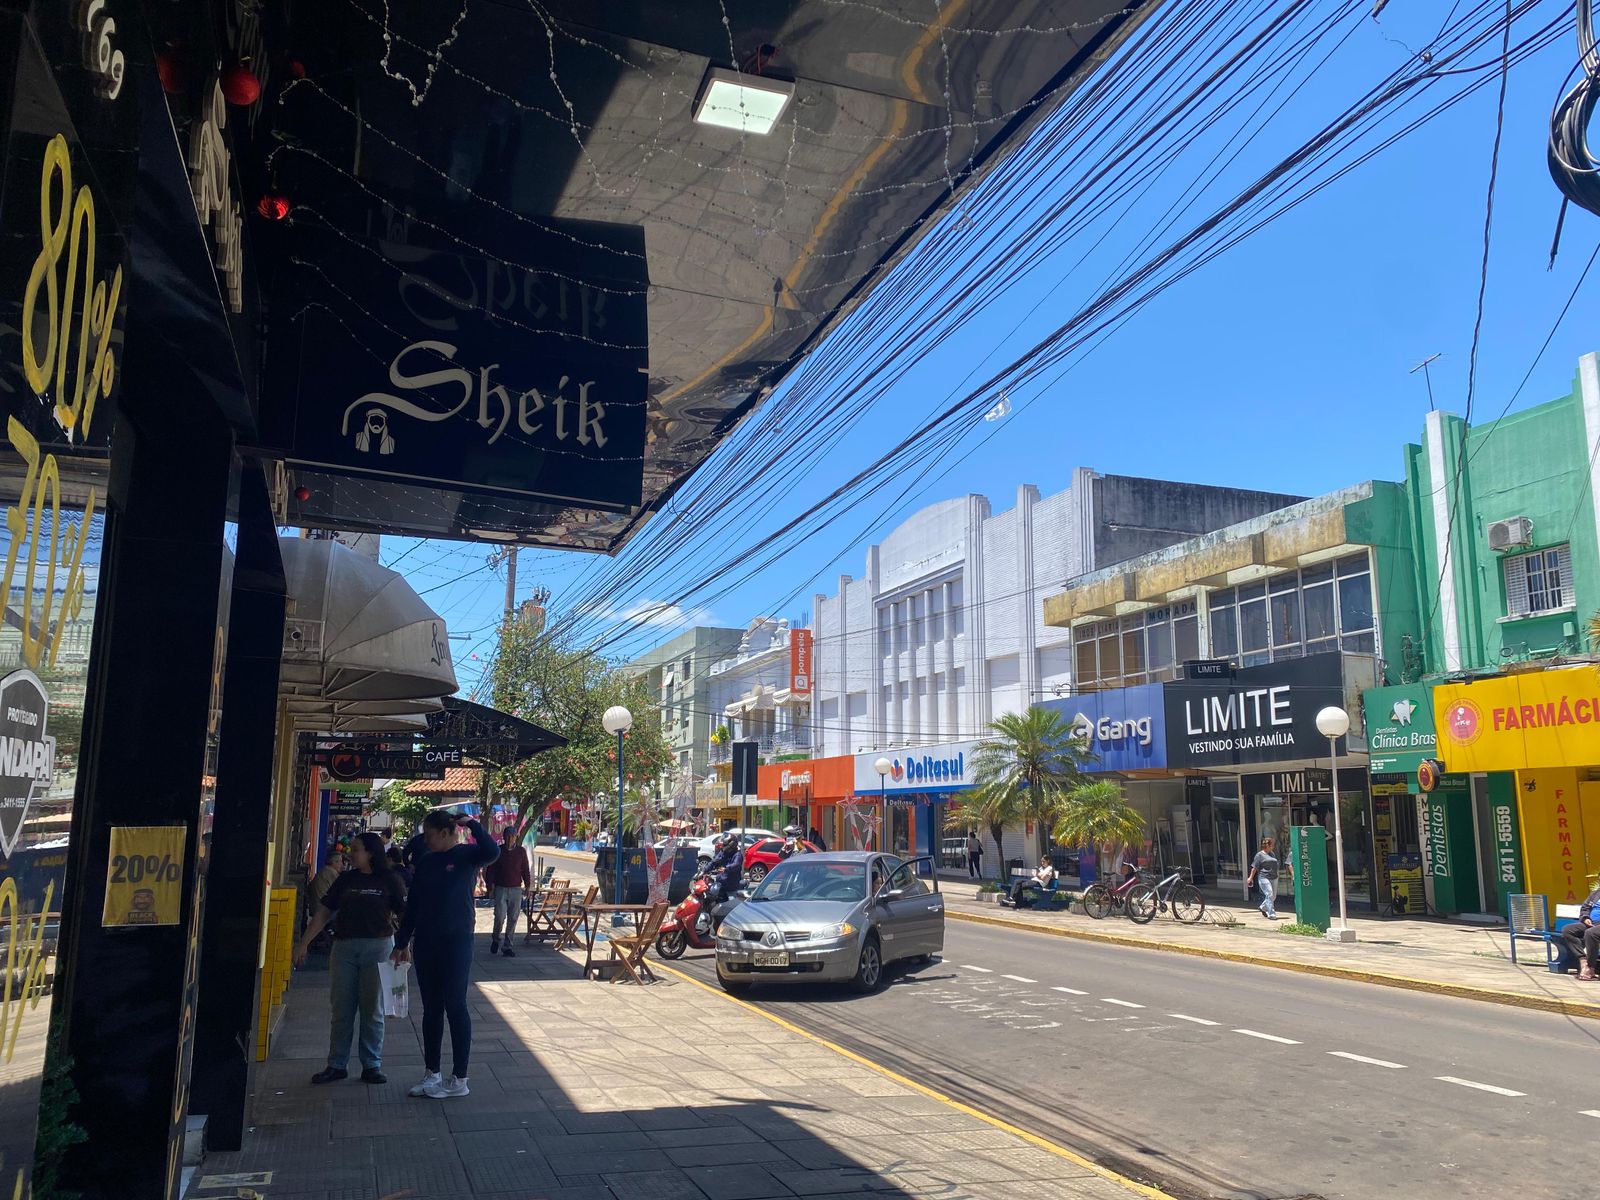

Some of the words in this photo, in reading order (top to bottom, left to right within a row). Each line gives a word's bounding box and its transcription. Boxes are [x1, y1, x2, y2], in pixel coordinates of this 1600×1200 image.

[341, 340, 609, 448] Sheik
[1197, 664, 1222, 674] LIMITE
[7, 706, 38, 727] PROTEGIDO
[1185, 685, 1293, 735] LIMITE
[1492, 696, 1600, 731] FARMÁCI
[1097, 716, 1152, 745] Gang
[1189, 738, 1233, 754] VESTINDO
[1234, 735, 1254, 750] SUA
[1255, 731, 1295, 748] FAMÍLIA
[1372, 734, 1408, 749] Clínica
[425, 750, 460, 762] CAFÉ
[906, 752, 963, 779] Deltasul
[1434, 804, 1448, 877] Dentistas
[1495, 805, 1517, 883] 3411-5559
[1555, 789, 1577, 901] FARMÁCIA
[111, 854, 180, 883] 20%
